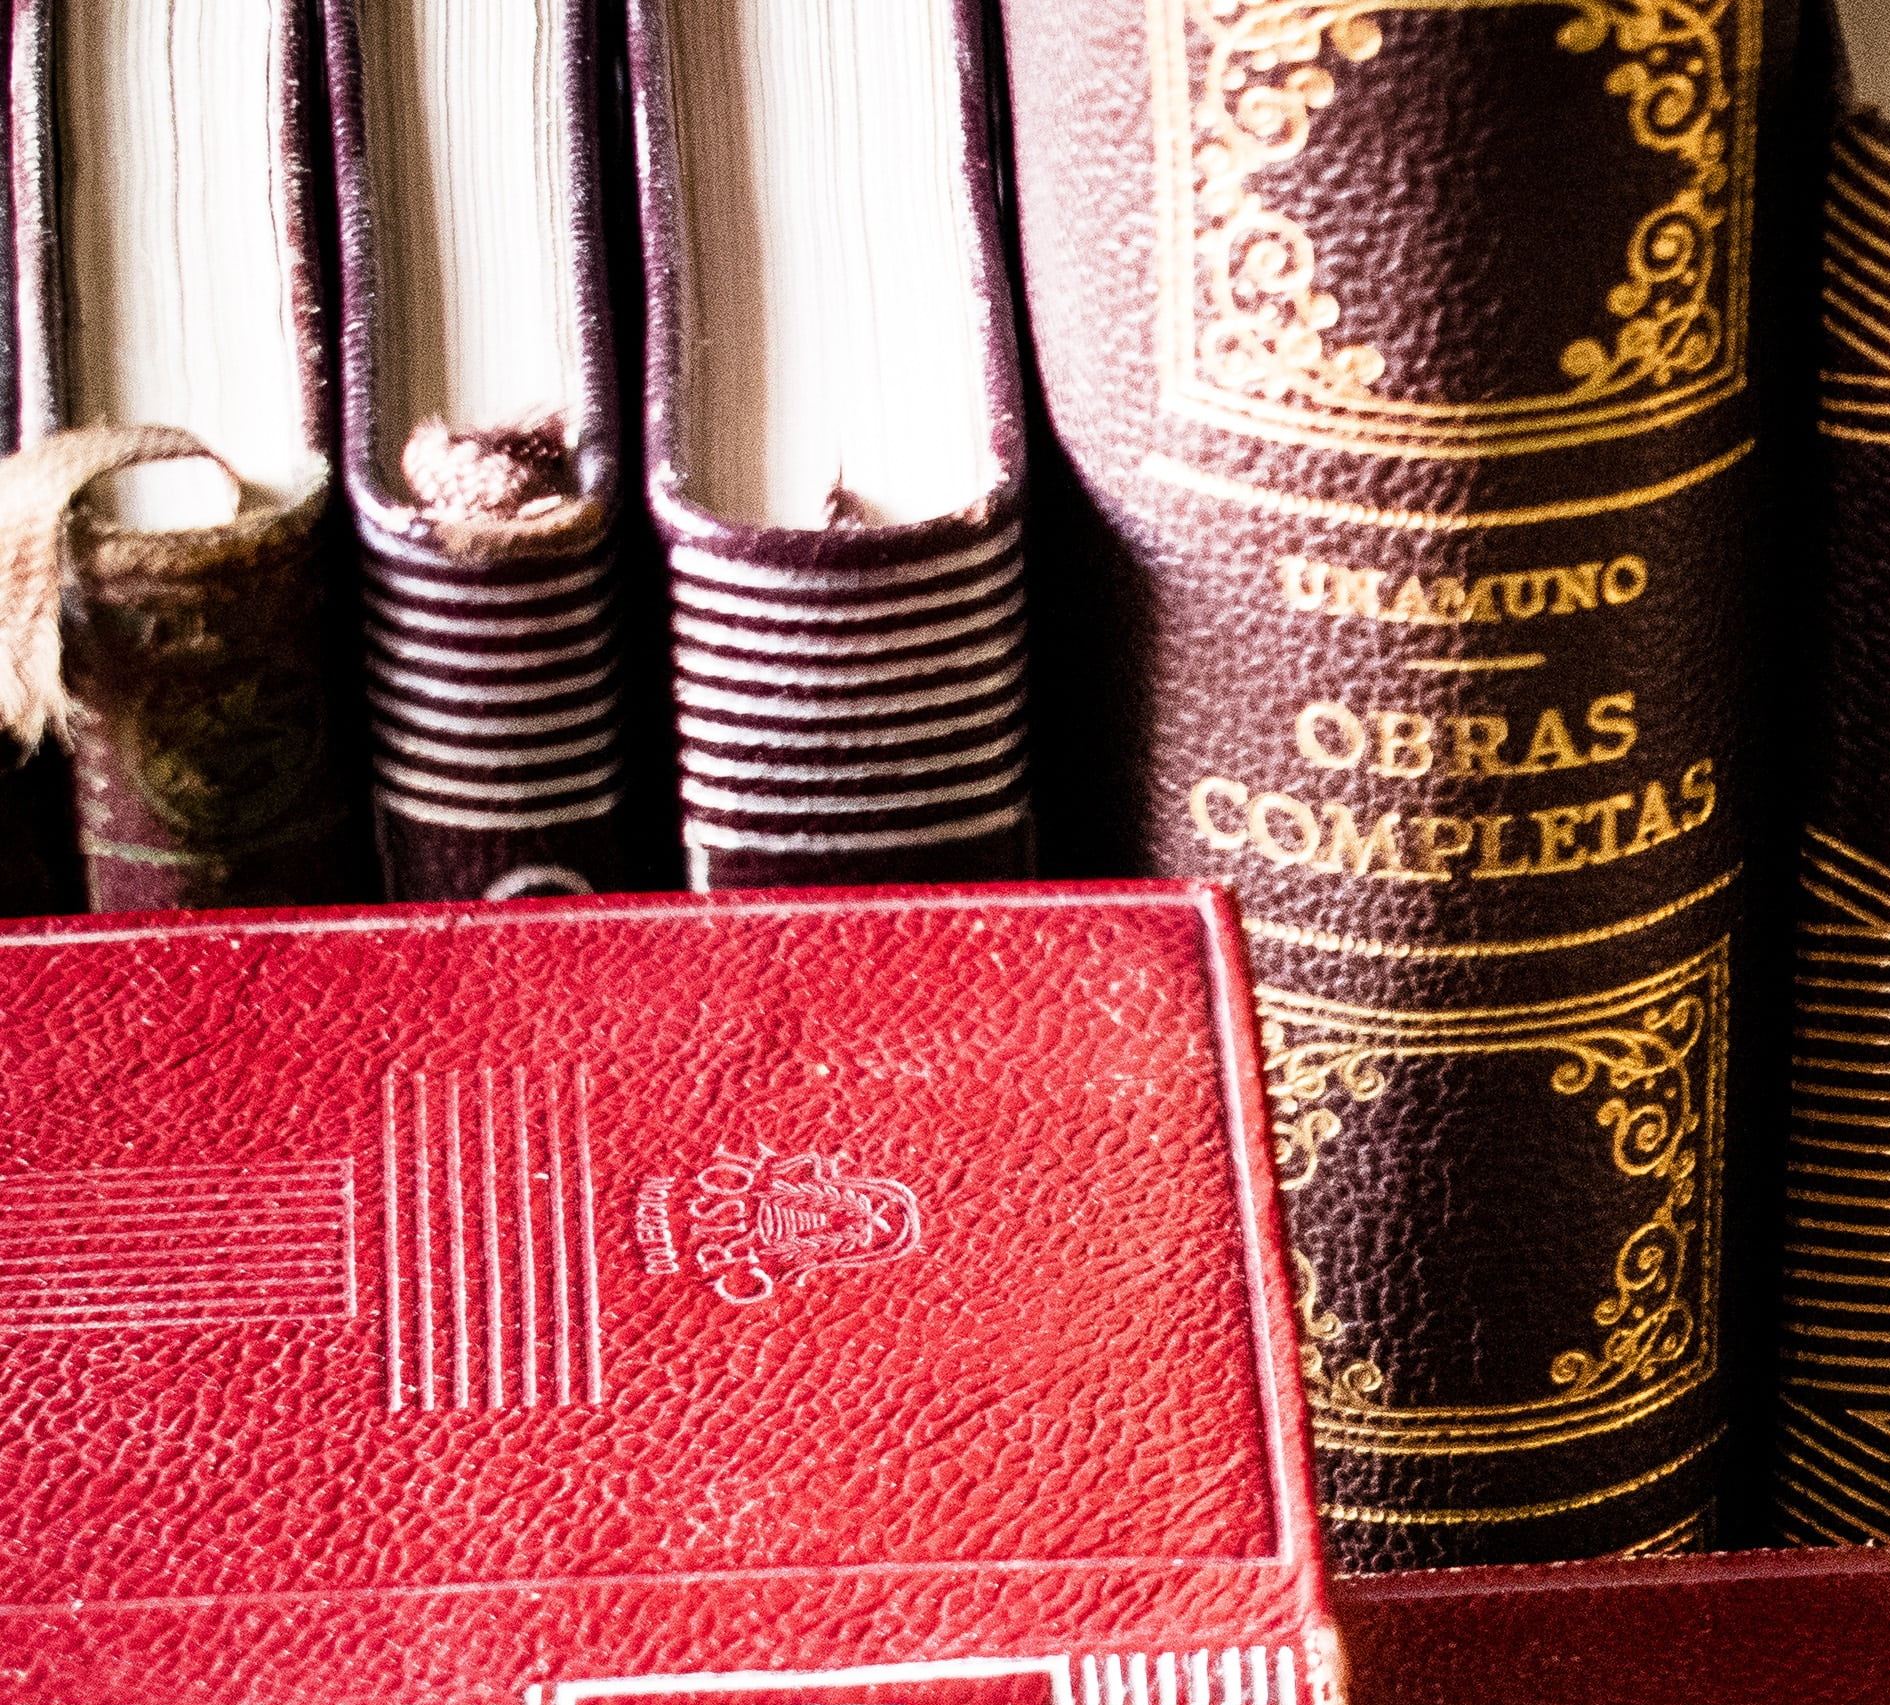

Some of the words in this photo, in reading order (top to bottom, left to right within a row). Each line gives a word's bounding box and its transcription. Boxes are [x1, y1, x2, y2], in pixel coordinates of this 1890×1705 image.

[1278, 554, 1648, 624] UNAMUNO
[1295, 691, 1640, 779] OBRAS
[1189, 757, 1717, 882] COMPLETAS
[688, 1142, 777, 1305] CRISOL
